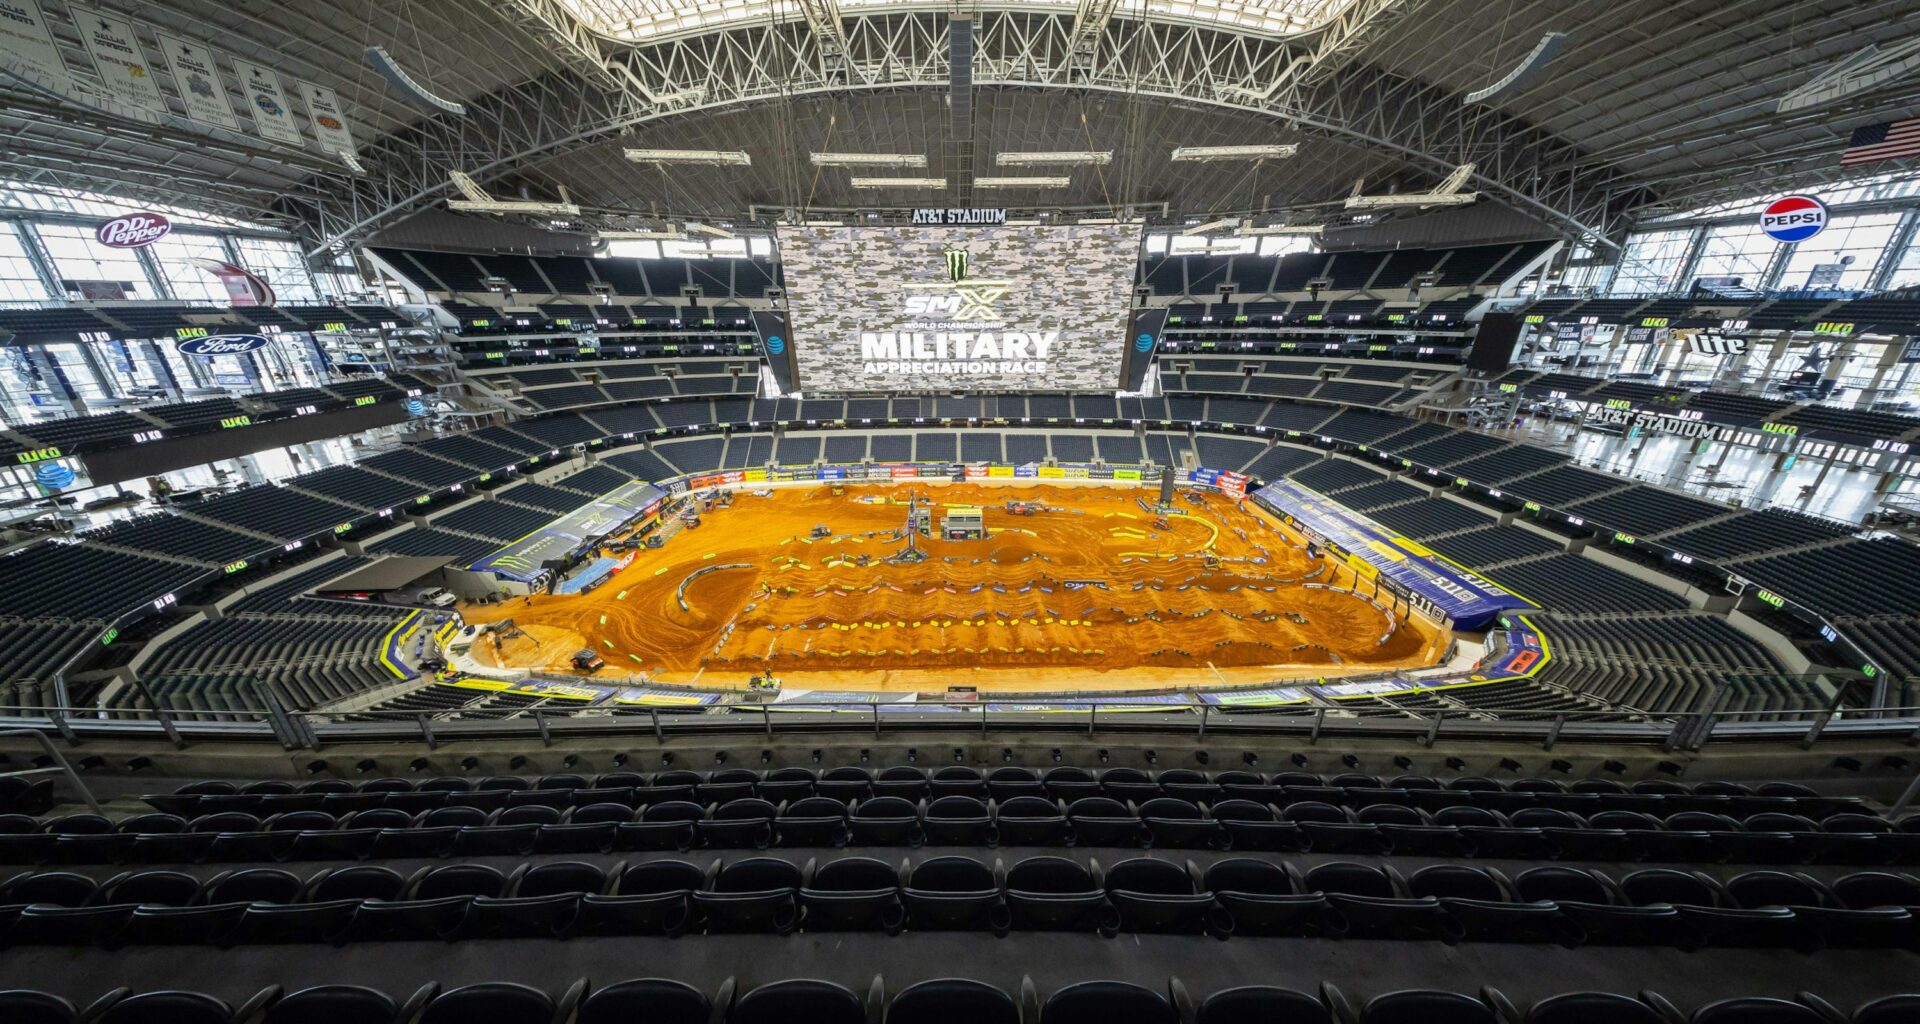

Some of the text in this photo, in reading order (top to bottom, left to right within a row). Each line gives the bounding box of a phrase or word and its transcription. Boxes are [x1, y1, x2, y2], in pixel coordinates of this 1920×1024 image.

[93, 31, 126, 45] DALLAS
[177, 55, 204, 69] DALLAS
[249, 78, 272, 89] DALLAS
[128, 217, 155, 231] Dr
[912, 209, 1007, 224] AT&T STADIUM
[1764, 212, 1822, 226] PEPSI
[100, 219, 167, 244] Pepper
[78, 331, 111, 342] DJ KO
[196, 336, 252, 353] Ford
[861, 333, 1059, 359] MILITARY
[1683, 334, 1748, 357] Lite
[863, 361, 1047, 374] APPRECIATION RACE
[1591, 407, 1722, 440] AT&T STADIUM
[133, 430, 163, 443] DJ KO
[1872, 439, 1910, 454] DJ KO
[1430, 576, 1462, 595] 5.11
[1409, 591, 1433, 614] 5.11
